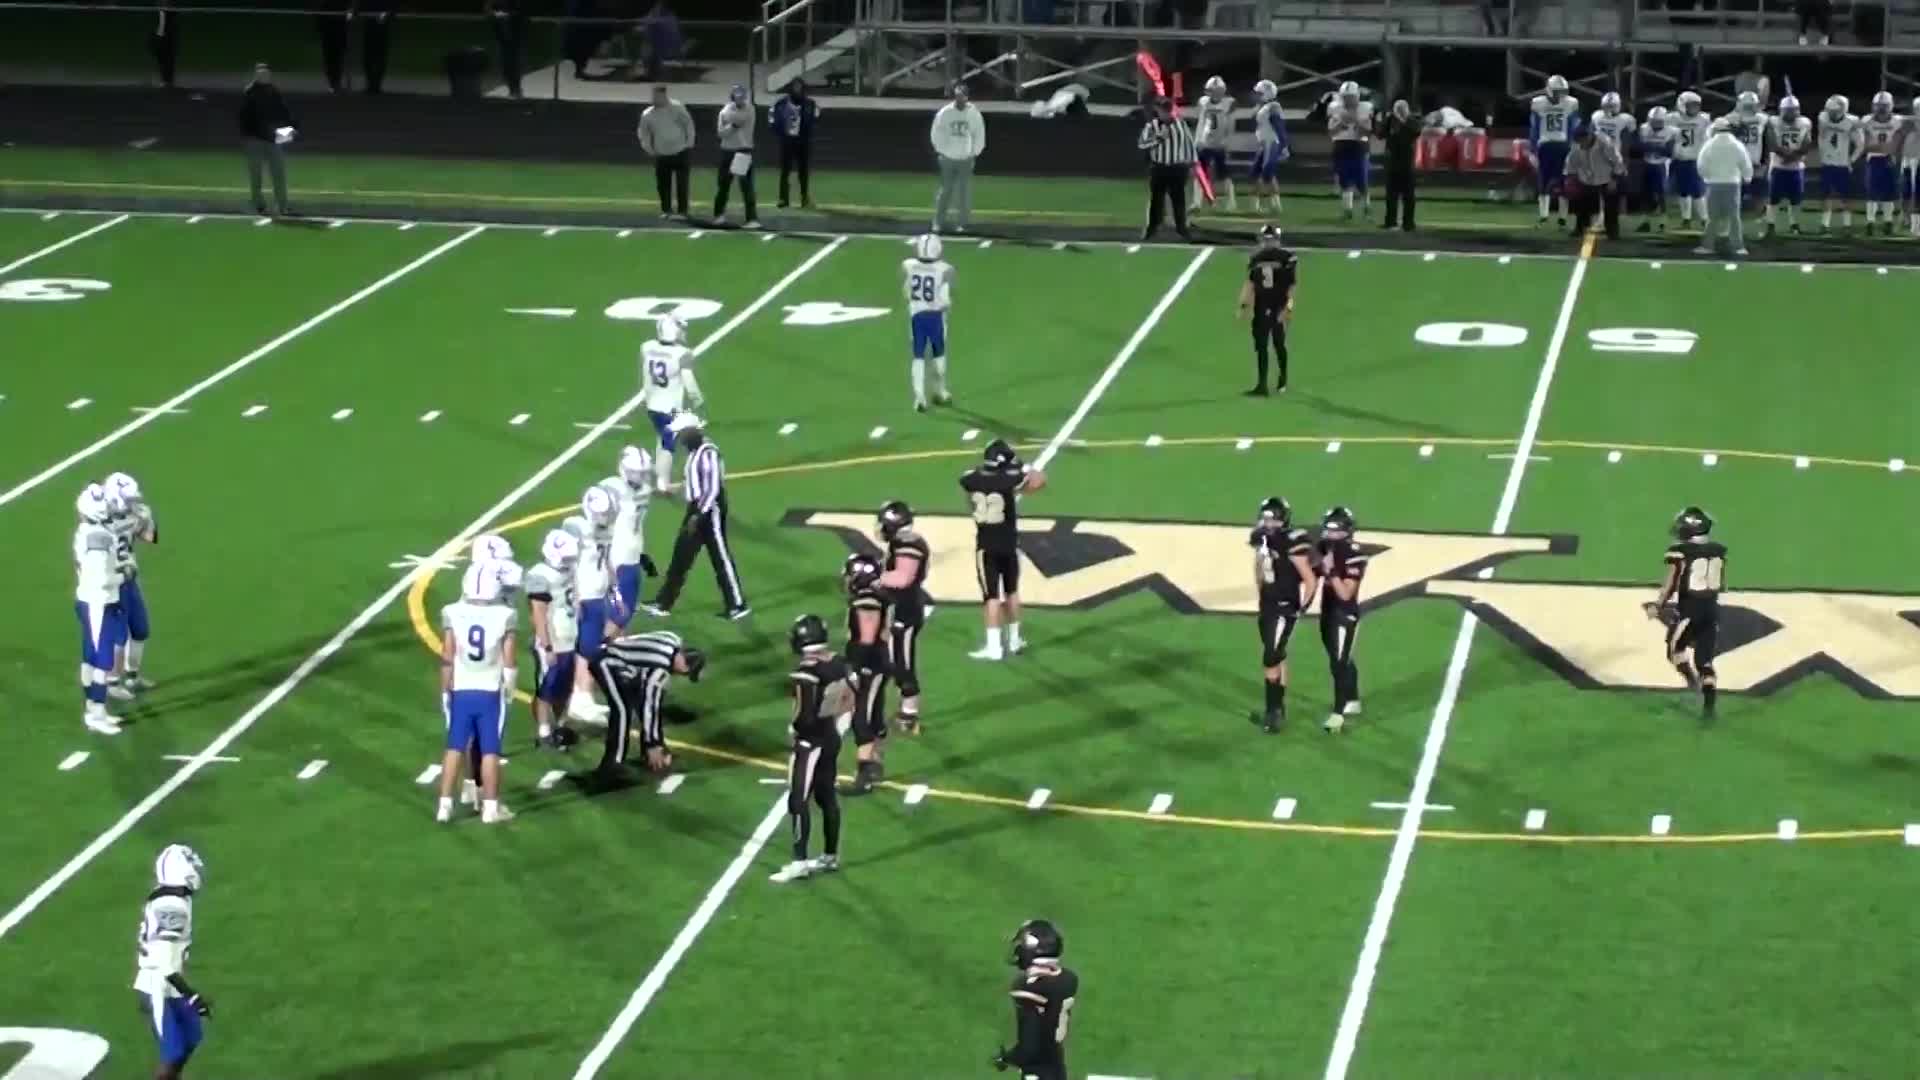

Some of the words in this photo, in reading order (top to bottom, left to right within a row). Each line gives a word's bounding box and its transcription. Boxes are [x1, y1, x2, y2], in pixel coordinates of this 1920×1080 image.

[911, 274, 935, 302] 28
[648, 359, 669, 388] 13
[467, 624, 486, 662] 9
